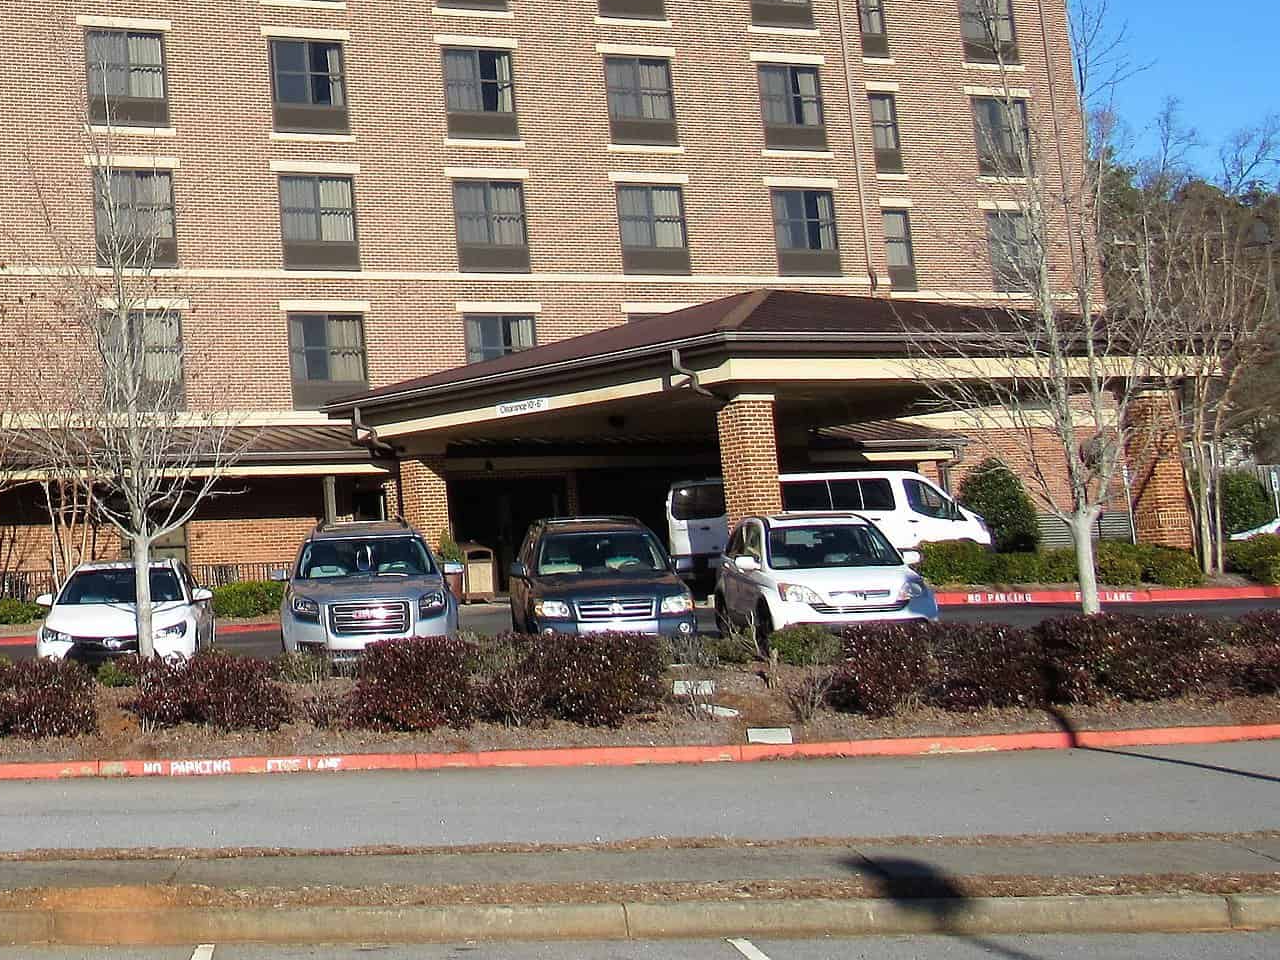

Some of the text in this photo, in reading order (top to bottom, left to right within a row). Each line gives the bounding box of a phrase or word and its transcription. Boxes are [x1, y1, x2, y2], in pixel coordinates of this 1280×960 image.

[968, 592, 981, 603] NO
[987, 592, 1032, 603] PARKING
[1106, 591, 1134, 601] LANE
[170, 760, 232, 775] PARKING
